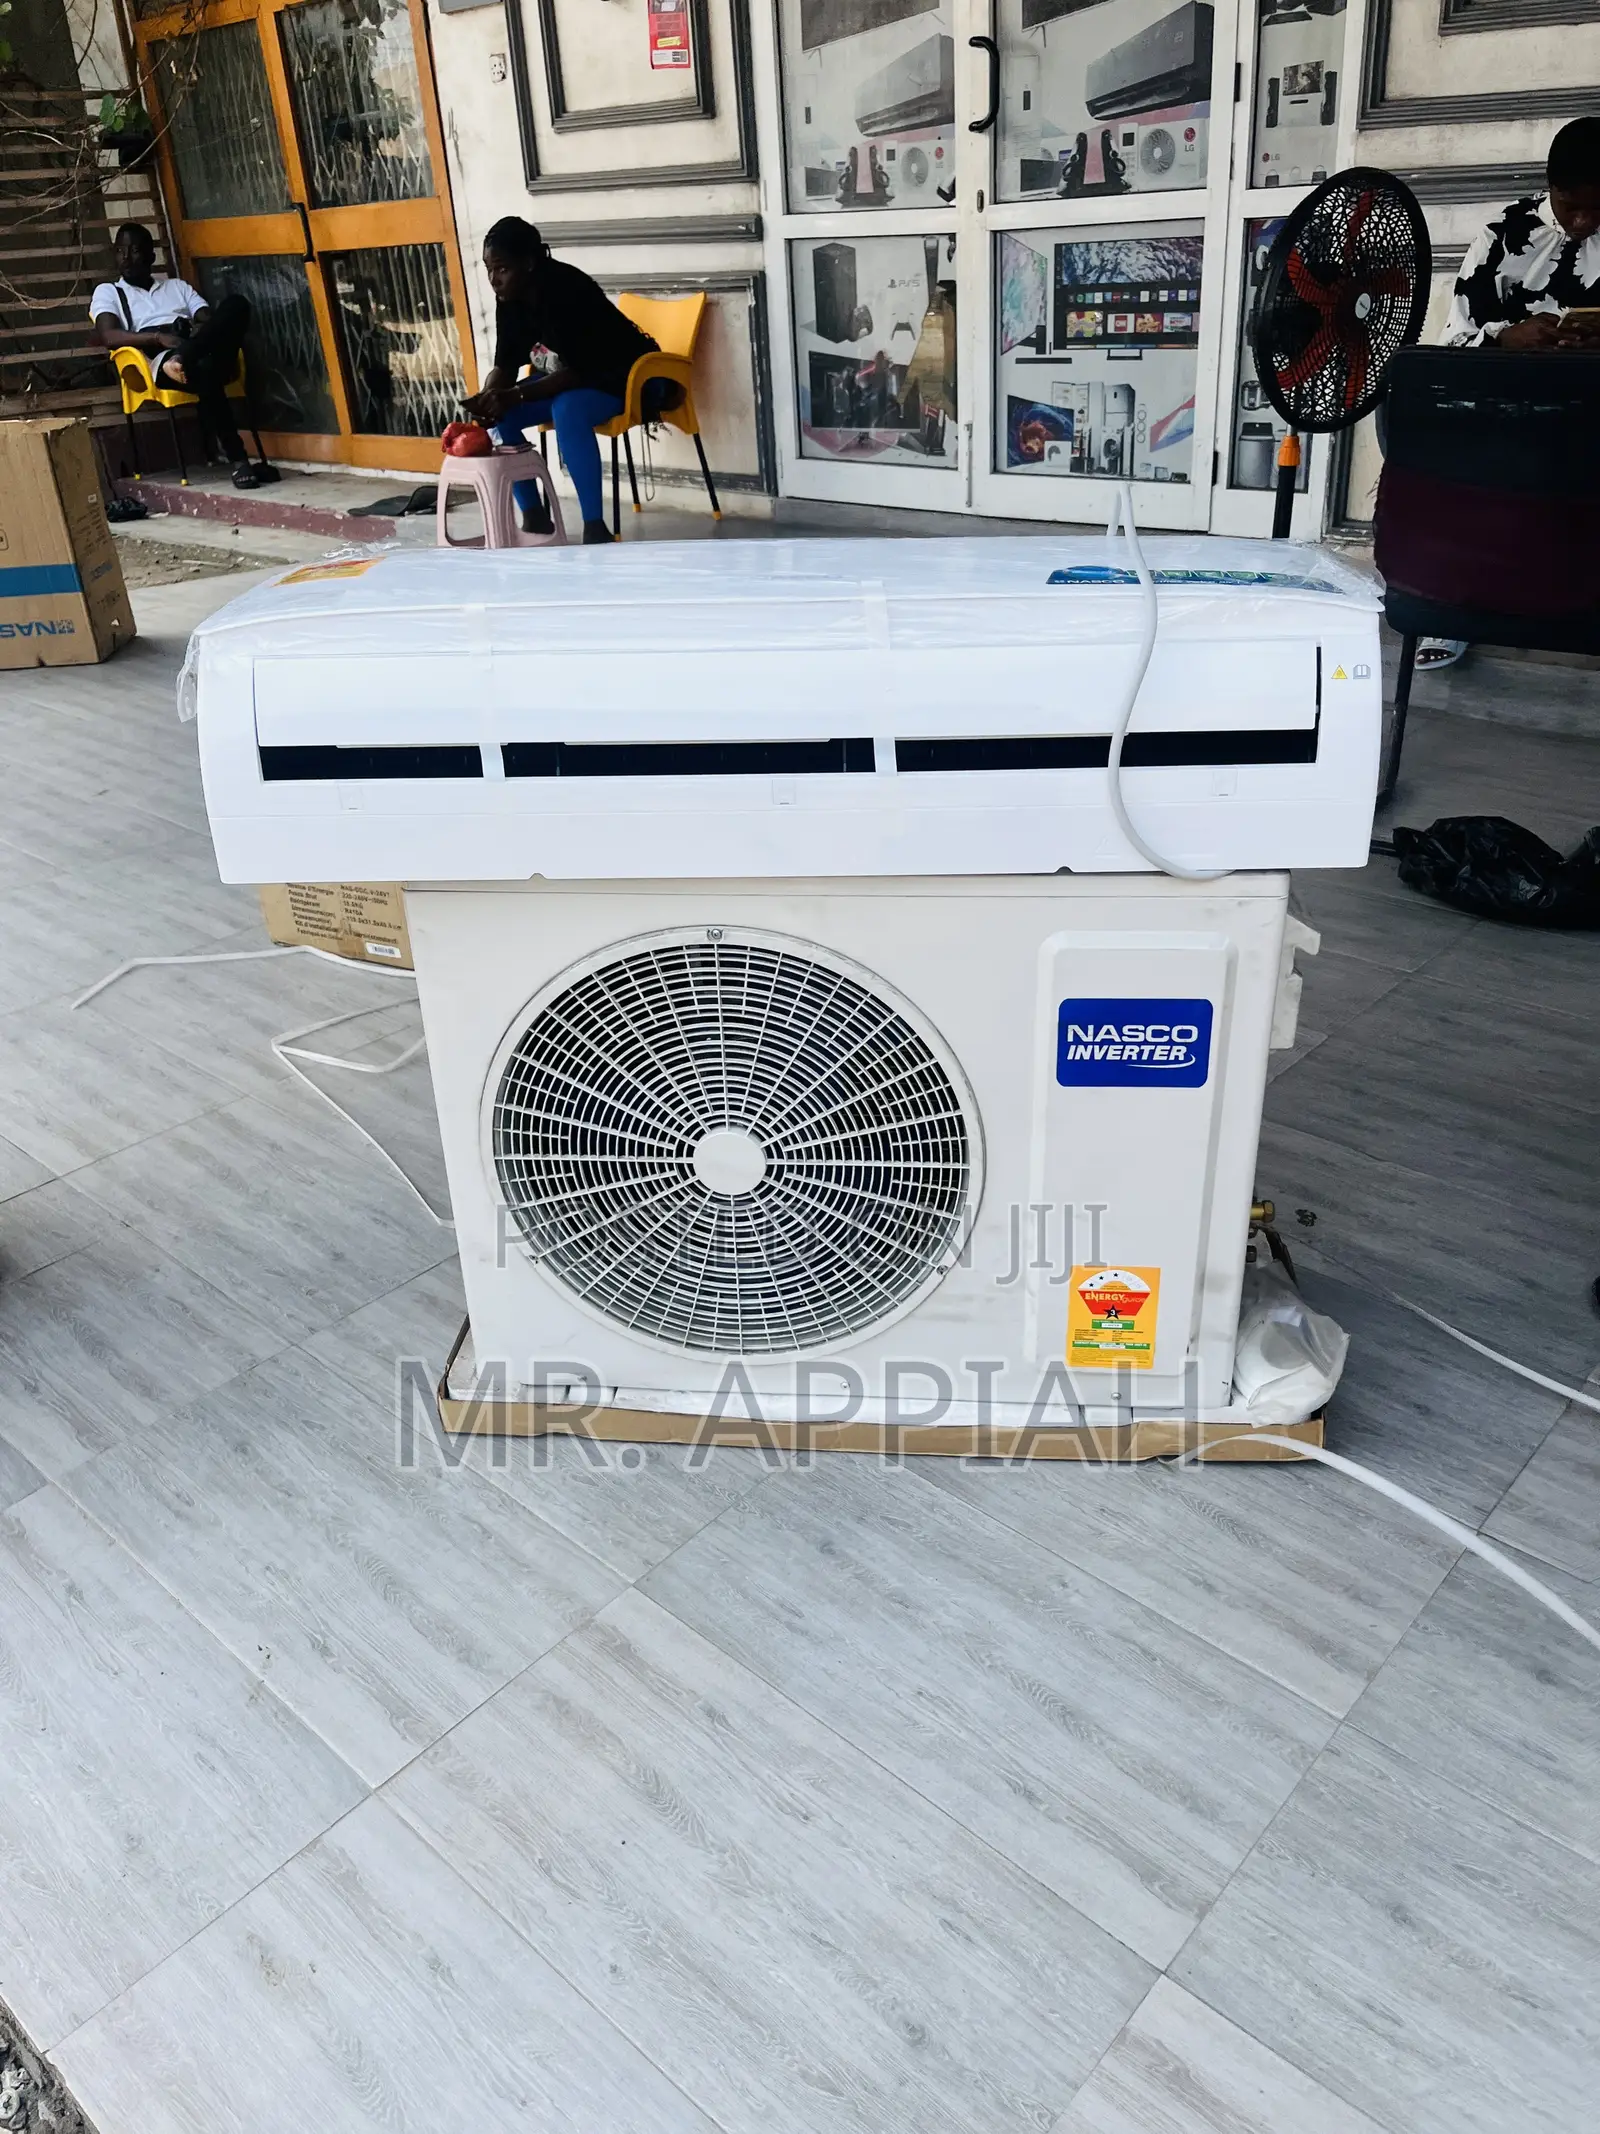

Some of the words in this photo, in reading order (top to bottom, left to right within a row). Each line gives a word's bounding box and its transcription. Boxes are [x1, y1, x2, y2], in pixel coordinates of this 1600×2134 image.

[1184, 144, 1195, 152] LG
[1271, 153, 1281, 161] LG
[898, 279, 921, 288] PS5
[1067, 1024, 1199, 1043] NASCO
[1067, 1045, 1188, 1061] INVERTER
[1085, 1292, 1124, 1303] ENERGY
